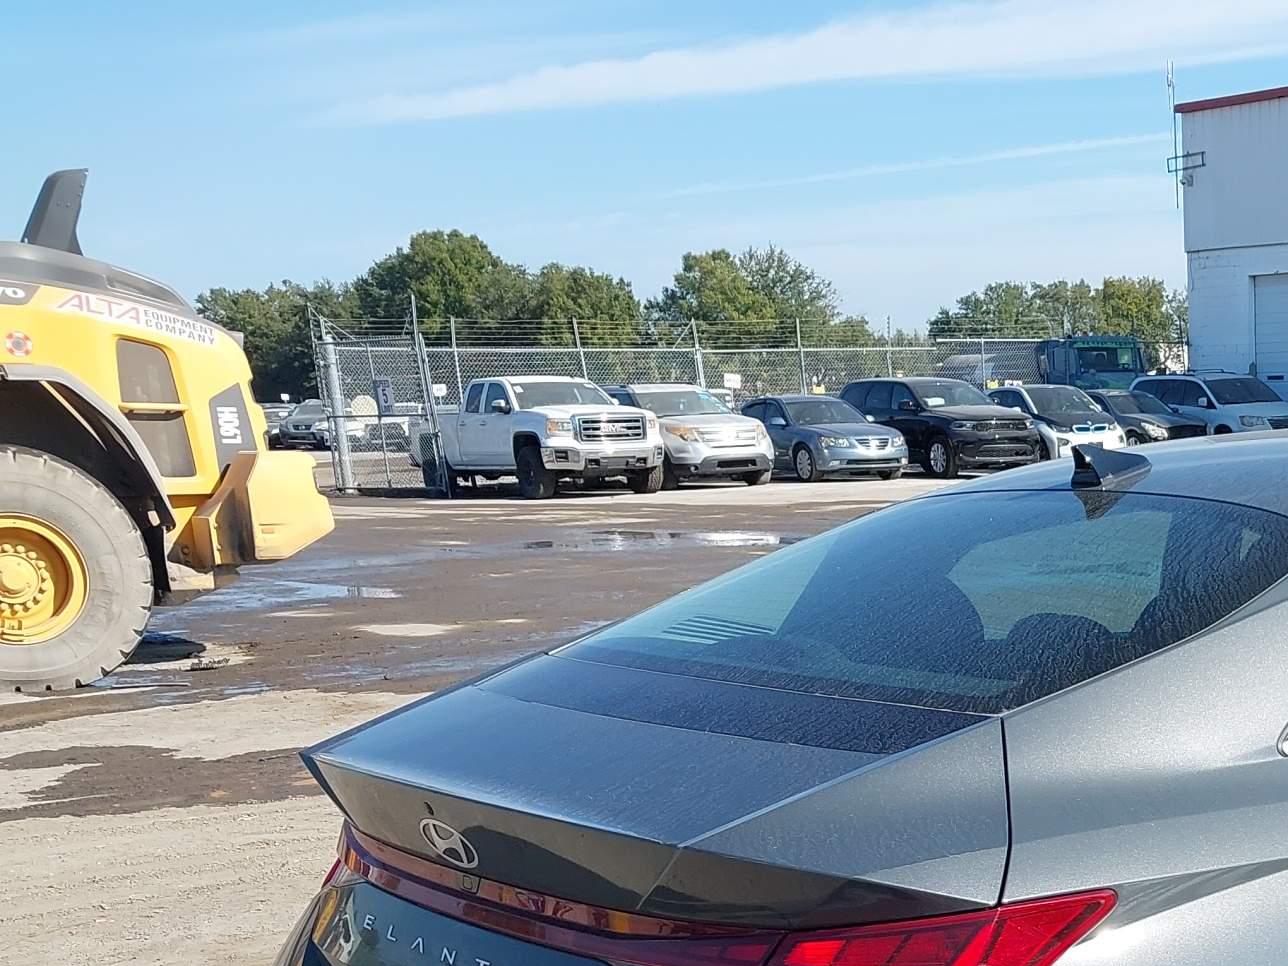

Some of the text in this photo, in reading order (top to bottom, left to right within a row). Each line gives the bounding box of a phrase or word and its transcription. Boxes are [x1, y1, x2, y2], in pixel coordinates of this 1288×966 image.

[56, 292, 142, 325] ALTA
[143, 309, 215, 336] EQUIPMENT
[145, 318, 215, 345] COMPANY
[381, 388, 389, 404] 5
[216, 406, 242, 444] L90H
